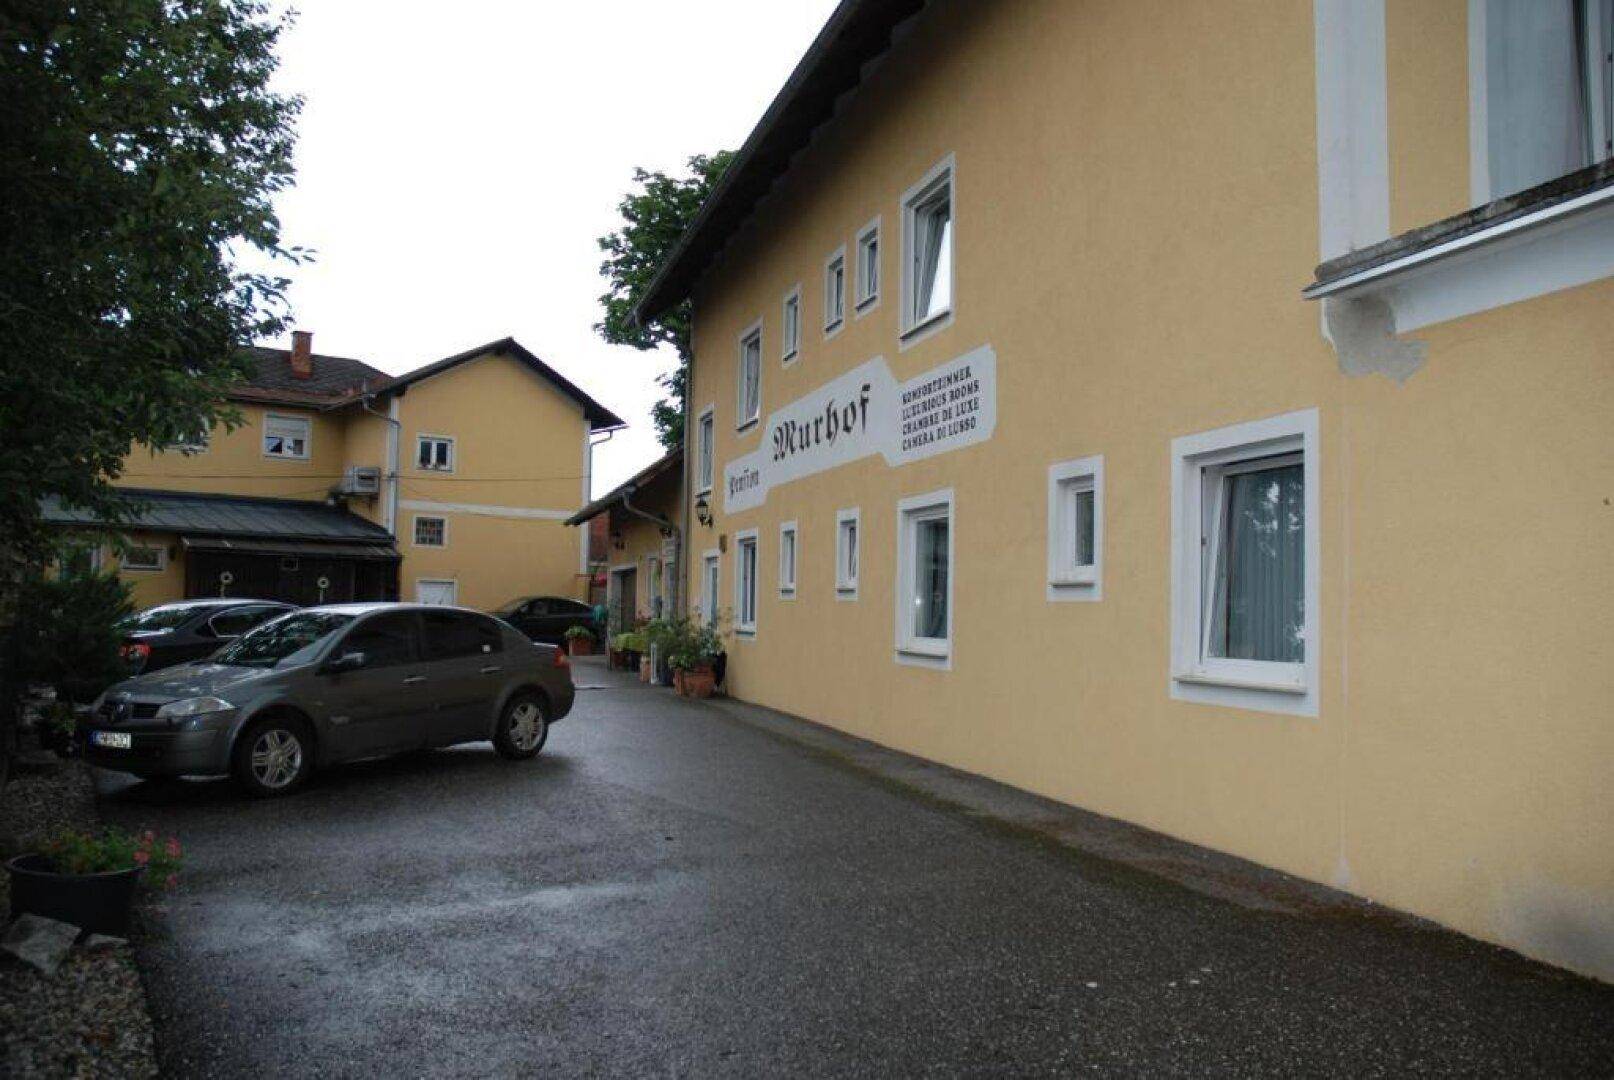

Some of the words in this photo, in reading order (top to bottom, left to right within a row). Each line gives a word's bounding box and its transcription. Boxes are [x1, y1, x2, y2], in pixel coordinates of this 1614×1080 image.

[949, 379, 980, 402] ROOMS
[773, 383, 871, 462] Murhof
[902, 413, 939, 435] CHAMBRE
[942, 406, 953, 421] DE
[956, 396, 980, 417] LUXE
[902, 431, 934, 451] CAMERA
[949, 415, 977, 435] LUSSO
